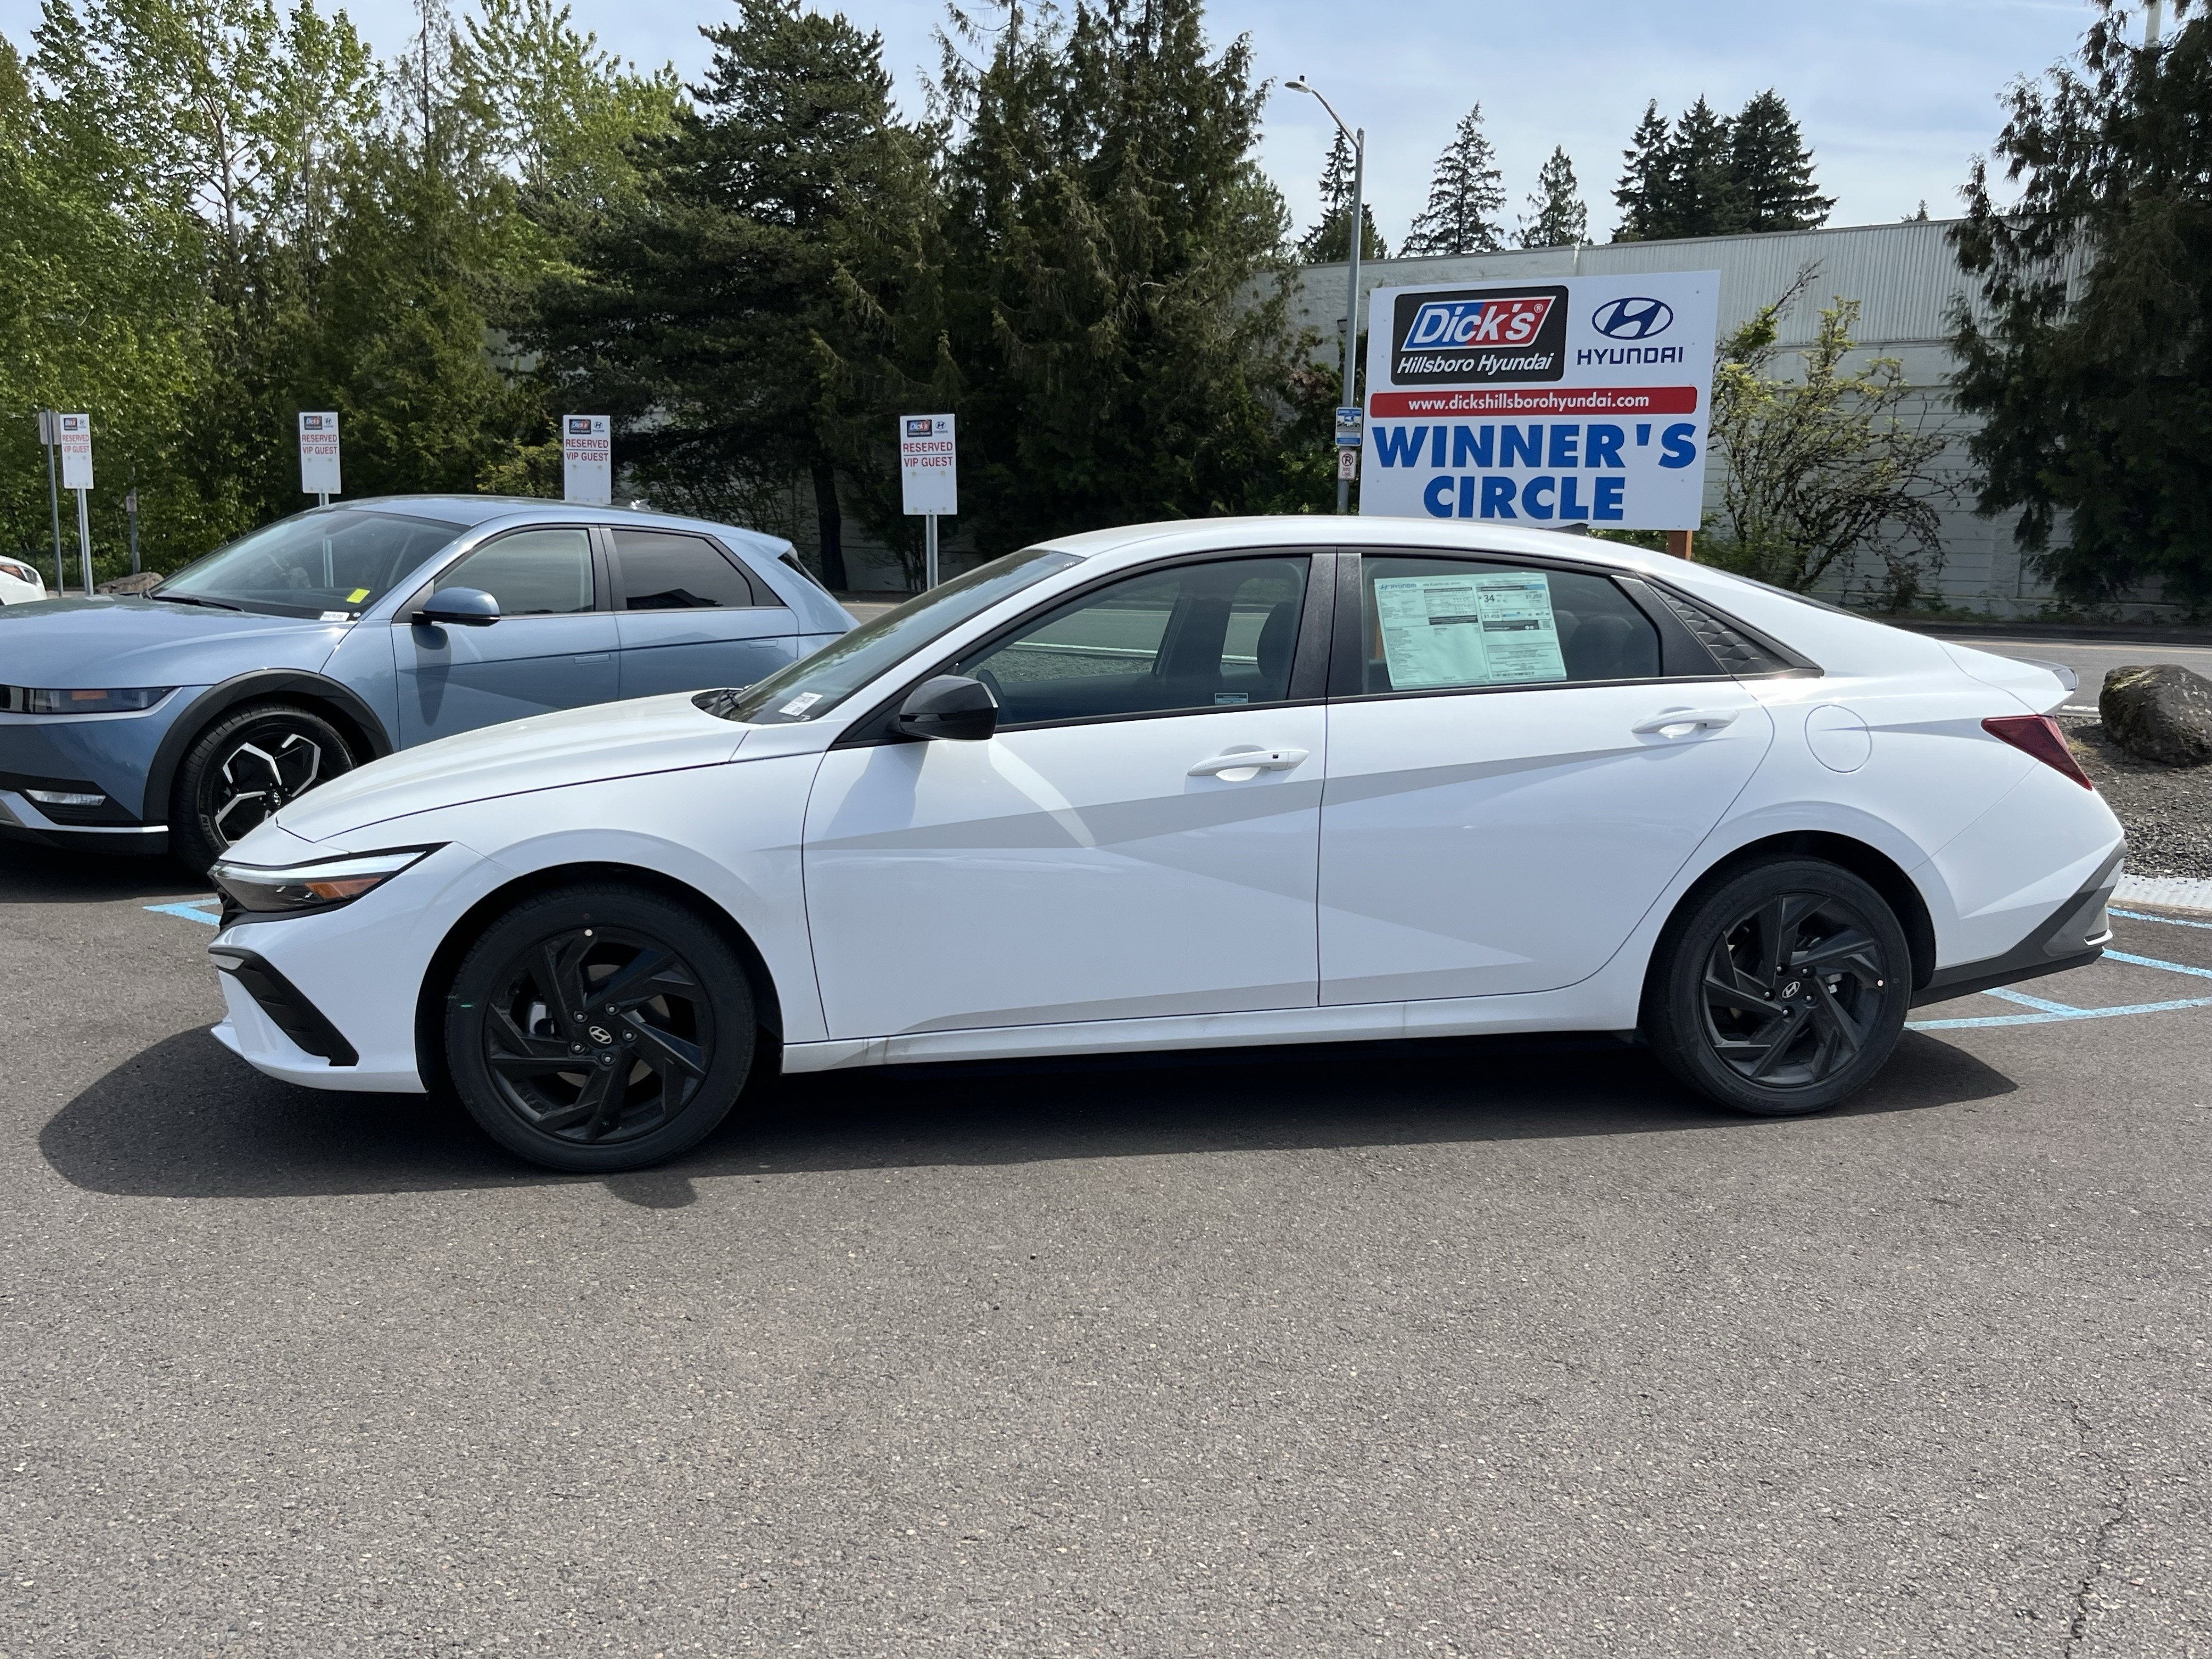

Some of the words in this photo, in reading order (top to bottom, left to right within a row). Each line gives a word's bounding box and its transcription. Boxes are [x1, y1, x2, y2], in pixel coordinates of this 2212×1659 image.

[1577, 347, 1683, 365] HYUNDAI
[1397, 356, 1475, 374] Hillsboro
[1477, 353, 1555, 376] Hyundai
[1408, 392, 1650, 411] www.dickshillsborohyundai.com
[302, 434, 337, 443] RESERVED
[565, 439, 608, 448] RESERVED
[315, 446, 337, 455] GUEST
[903, 442, 953, 453] RESERVED
[1372, 423, 1697, 469] WINNER'S
[566, 452, 578, 460] VIP
[582, 452, 608, 461] GUEST
[904, 457, 918, 467] VIP
[921, 456, 953, 467] GUEST
[1424, 476, 1626, 521] CIRCLE
[1483, 594, 1495, 602] 34
